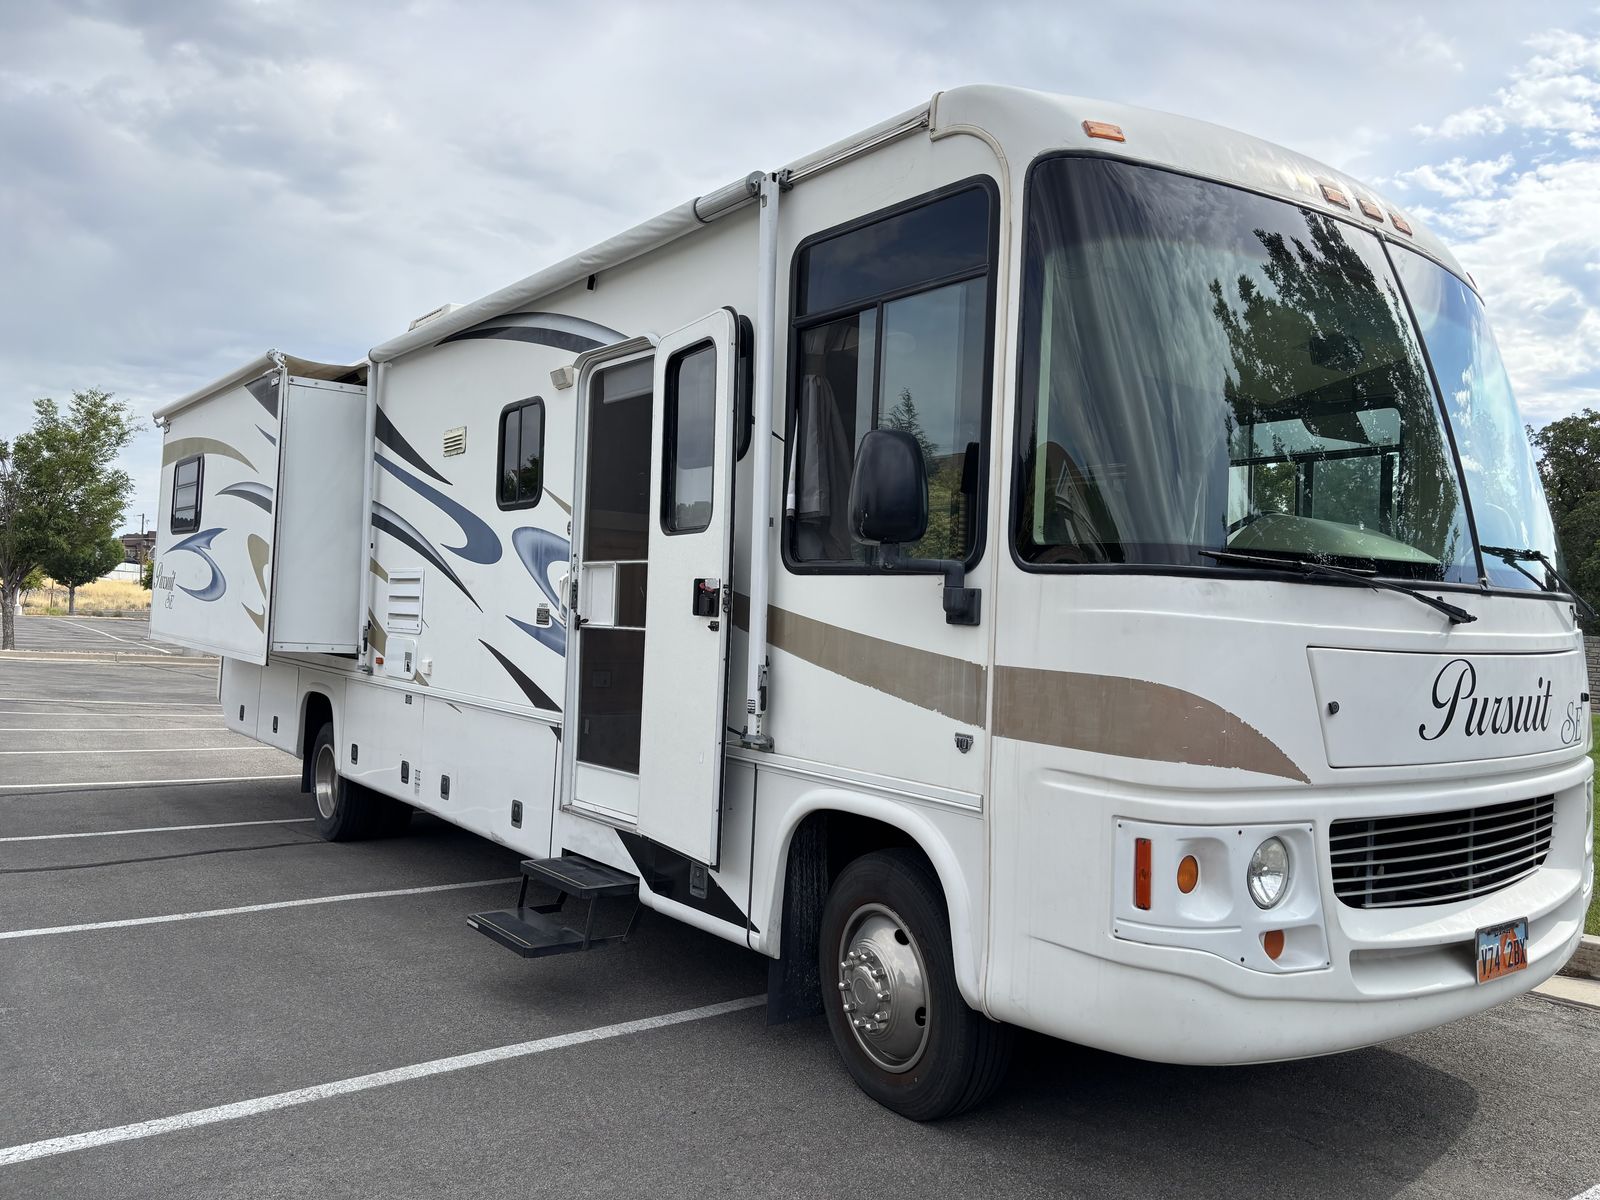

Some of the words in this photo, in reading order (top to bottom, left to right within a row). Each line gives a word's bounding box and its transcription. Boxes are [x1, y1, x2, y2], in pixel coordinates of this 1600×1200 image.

[154, 562, 177, 591] Pursuit
[165, 592, 175, 609] SE
[1418, 658, 1552, 740] Pursuit
[1561, 700, 1582, 745] SE
[1481, 944, 1500, 976] V74
